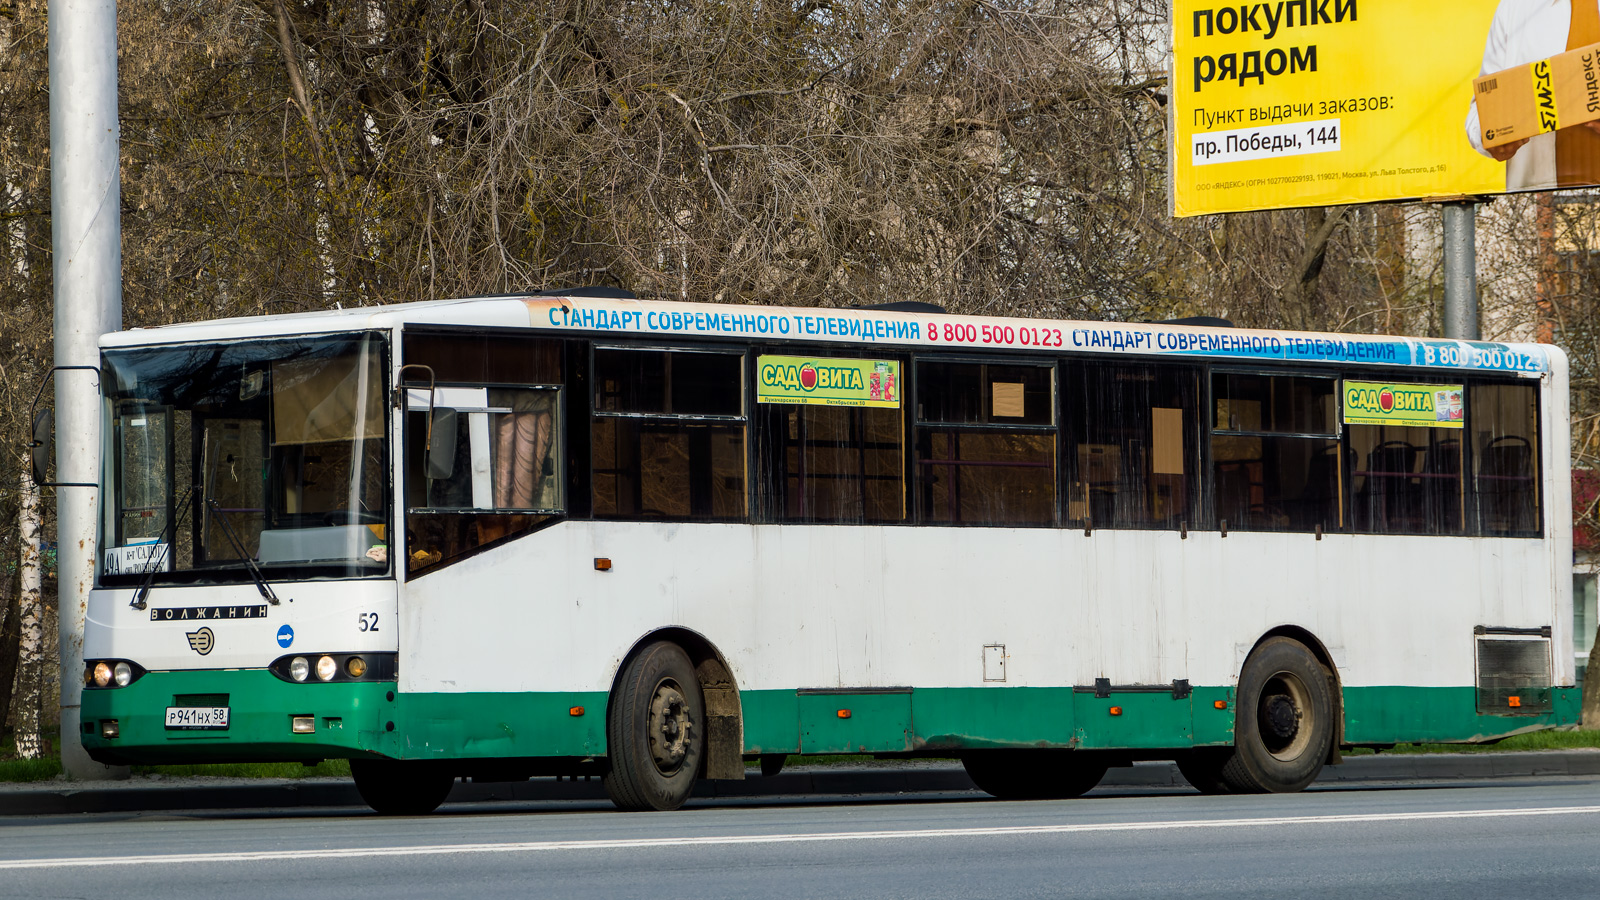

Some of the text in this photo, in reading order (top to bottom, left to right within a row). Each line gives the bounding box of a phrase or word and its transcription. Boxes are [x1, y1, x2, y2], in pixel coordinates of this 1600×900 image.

[1193, 0, 1357, 39] покупки
[1193, 45, 1317, 92] рядом
[1581, 53, 1600, 113] Яндекс
[1194, 96, 1394, 129] Пункт выдачи заказов:
[1195, 126, 1338, 158] пр. Победы, 144
[1212, 180, 1245, 190] «ЯНДЕКС»
[1246, 178, 1266, 188] (ОГРН
[1317, 172, 1340, 181] 119021,
[1342, 171, 1368, 179] Москва,
[1398, 166, 1429, 175] Толстого,
[549, 307, 1062, 347] СТАНДАРТ СОВРЕМЕННОГО ТЕЛЕВИДЕНИЯ 8 800 500 0123
[1072, 329, 1543, 370] СТАНДАРТ СОВРЕМЕННОГО ТЕЛЕВИДЕНИЯ 8 800 500 0123
[762, 362, 864, 392] САДОВИТА
[1347, 387, 1434, 414] САДОВИТА
[151, 606, 268, 620] ВОЛЖАНИН
[358, 612, 379, 632] 52
[214, 709, 224, 720] 58
